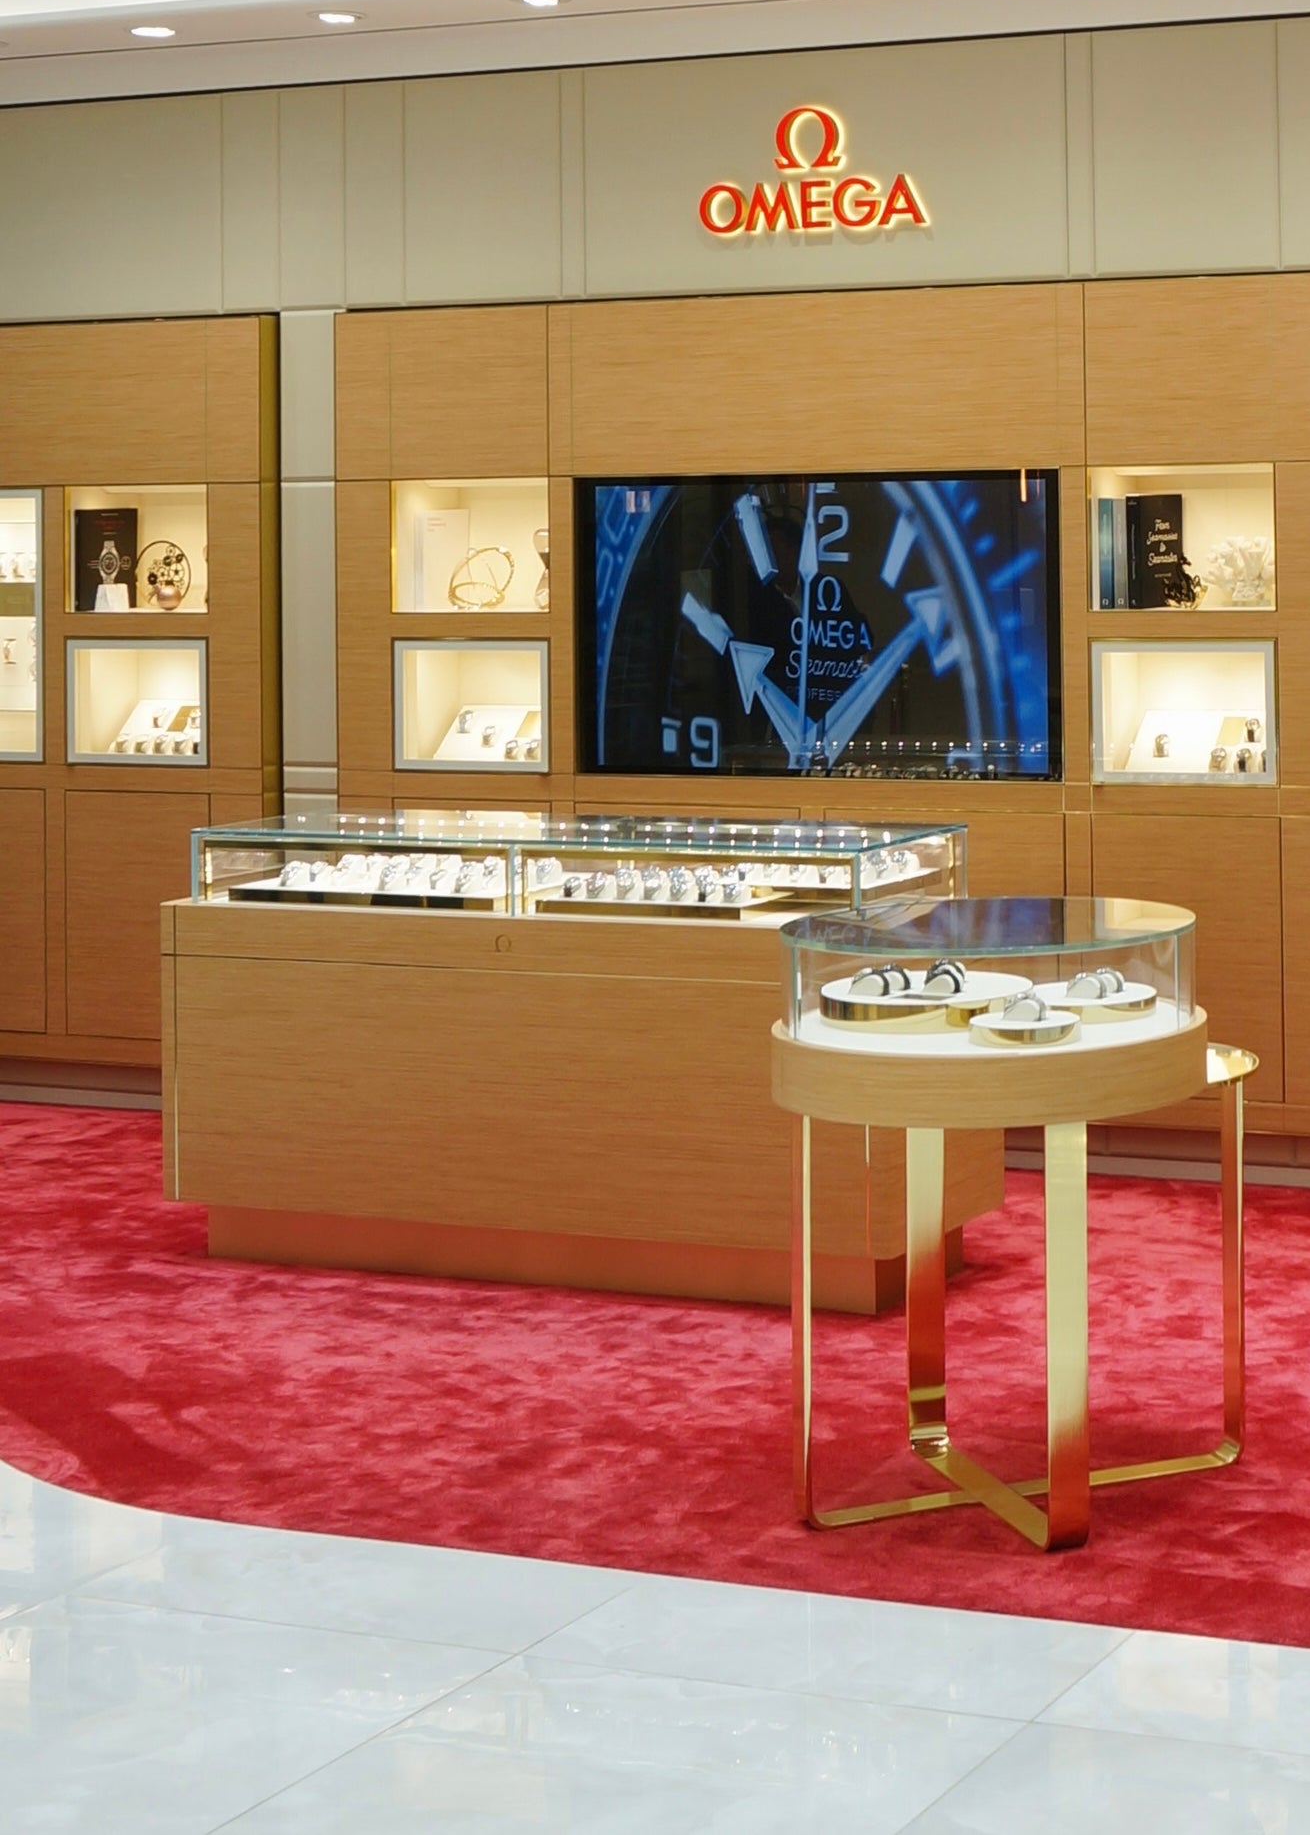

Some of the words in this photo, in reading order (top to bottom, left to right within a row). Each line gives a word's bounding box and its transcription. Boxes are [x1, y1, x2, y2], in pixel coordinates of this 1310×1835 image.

[699, 174, 926, 233] OMEGA
[791, 617, 872, 650] OMEGA
[690, 717, 719, 768] 9
